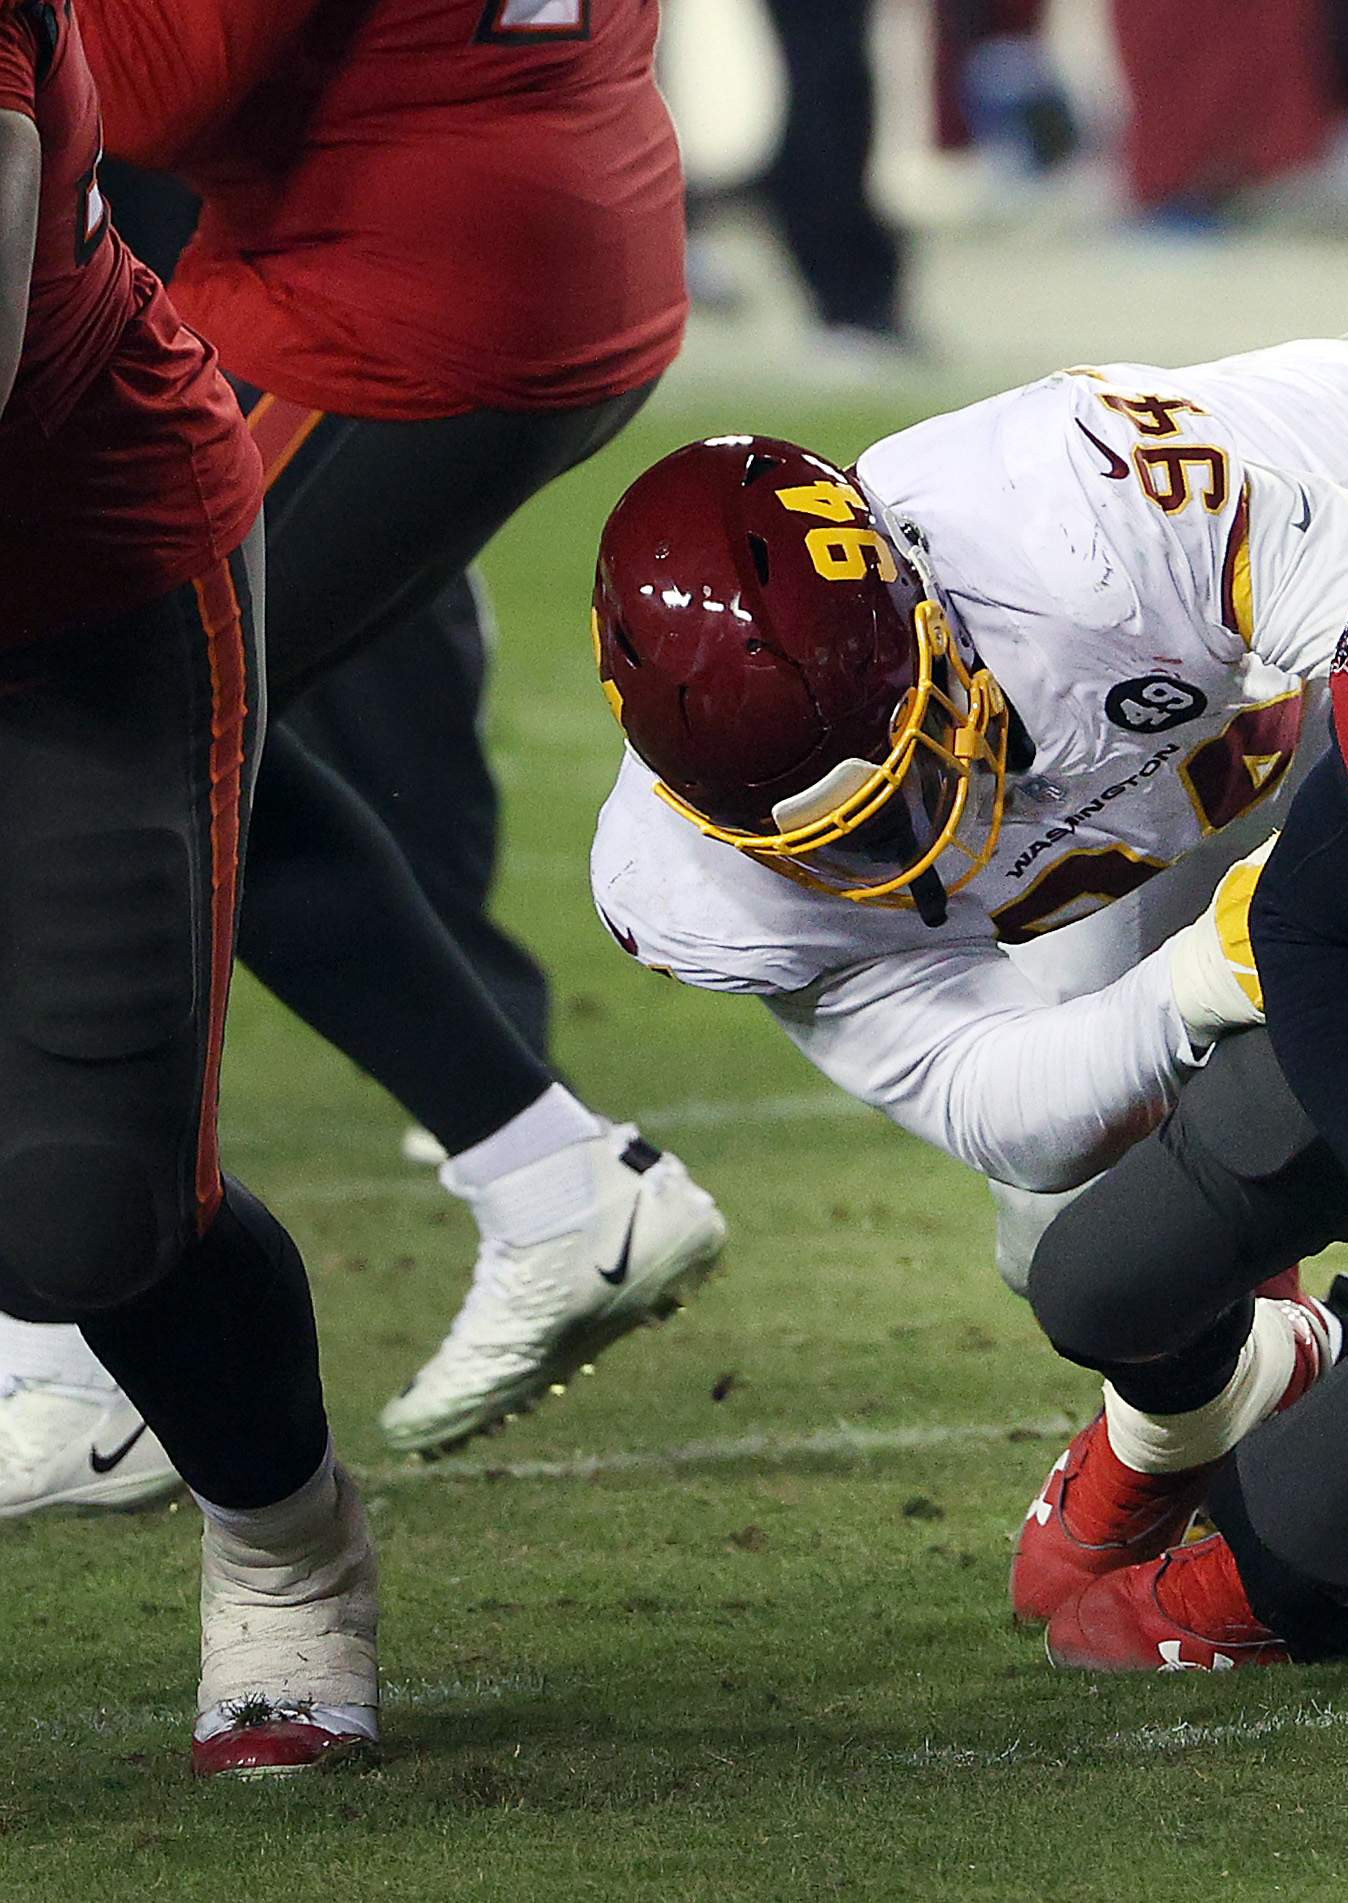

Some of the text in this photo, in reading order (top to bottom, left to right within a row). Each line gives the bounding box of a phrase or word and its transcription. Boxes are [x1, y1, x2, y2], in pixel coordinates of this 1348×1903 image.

[1096, 392, 1230, 515] 94
[775, 480, 898, 583] 94
[1119, 681, 1195, 727] 49
